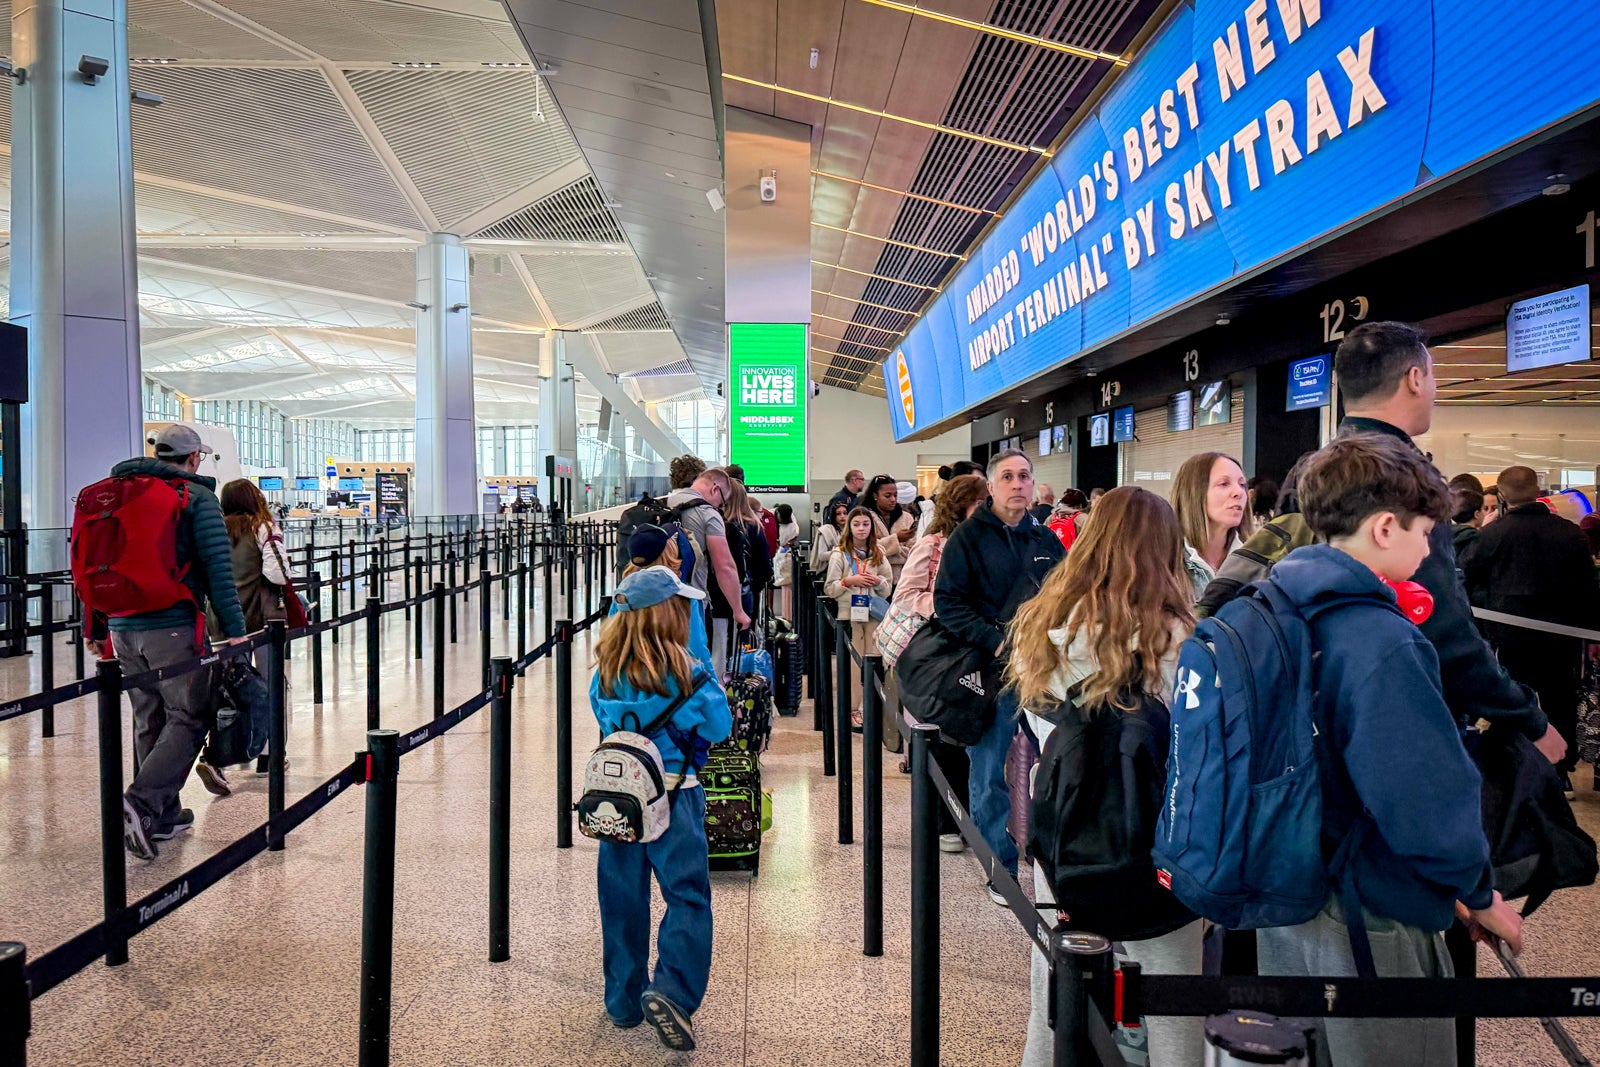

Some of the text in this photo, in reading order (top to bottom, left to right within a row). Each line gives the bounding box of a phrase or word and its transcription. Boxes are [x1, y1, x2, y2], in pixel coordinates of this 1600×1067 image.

[966, 0, 1321, 325] AWARDED "WORLD'S BEST NEW
[968, 26, 1388, 372] AIRPORT TERMINAL" BY SKYTRAX
[1575, 210, 1600, 269] 1
[1319, 299, 1346, 343] 12
[742, 367, 794, 375] INNOVATION
[1183, 349, 1200, 382] 13
[742, 375, 795, 389] LIVES
[1101, 381, 1112, 408] 14
[742, 389, 794, 404] HERE
[740, 416, 794, 424] MIDDLESEX
[1045, 401, 1054, 424] 15
[958, 677, 986, 696] adidas
[327, 778, 341, 797] EWR
[138, 879, 190, 924] Terminal A
[1036, 921, 1050, 951] EWR
